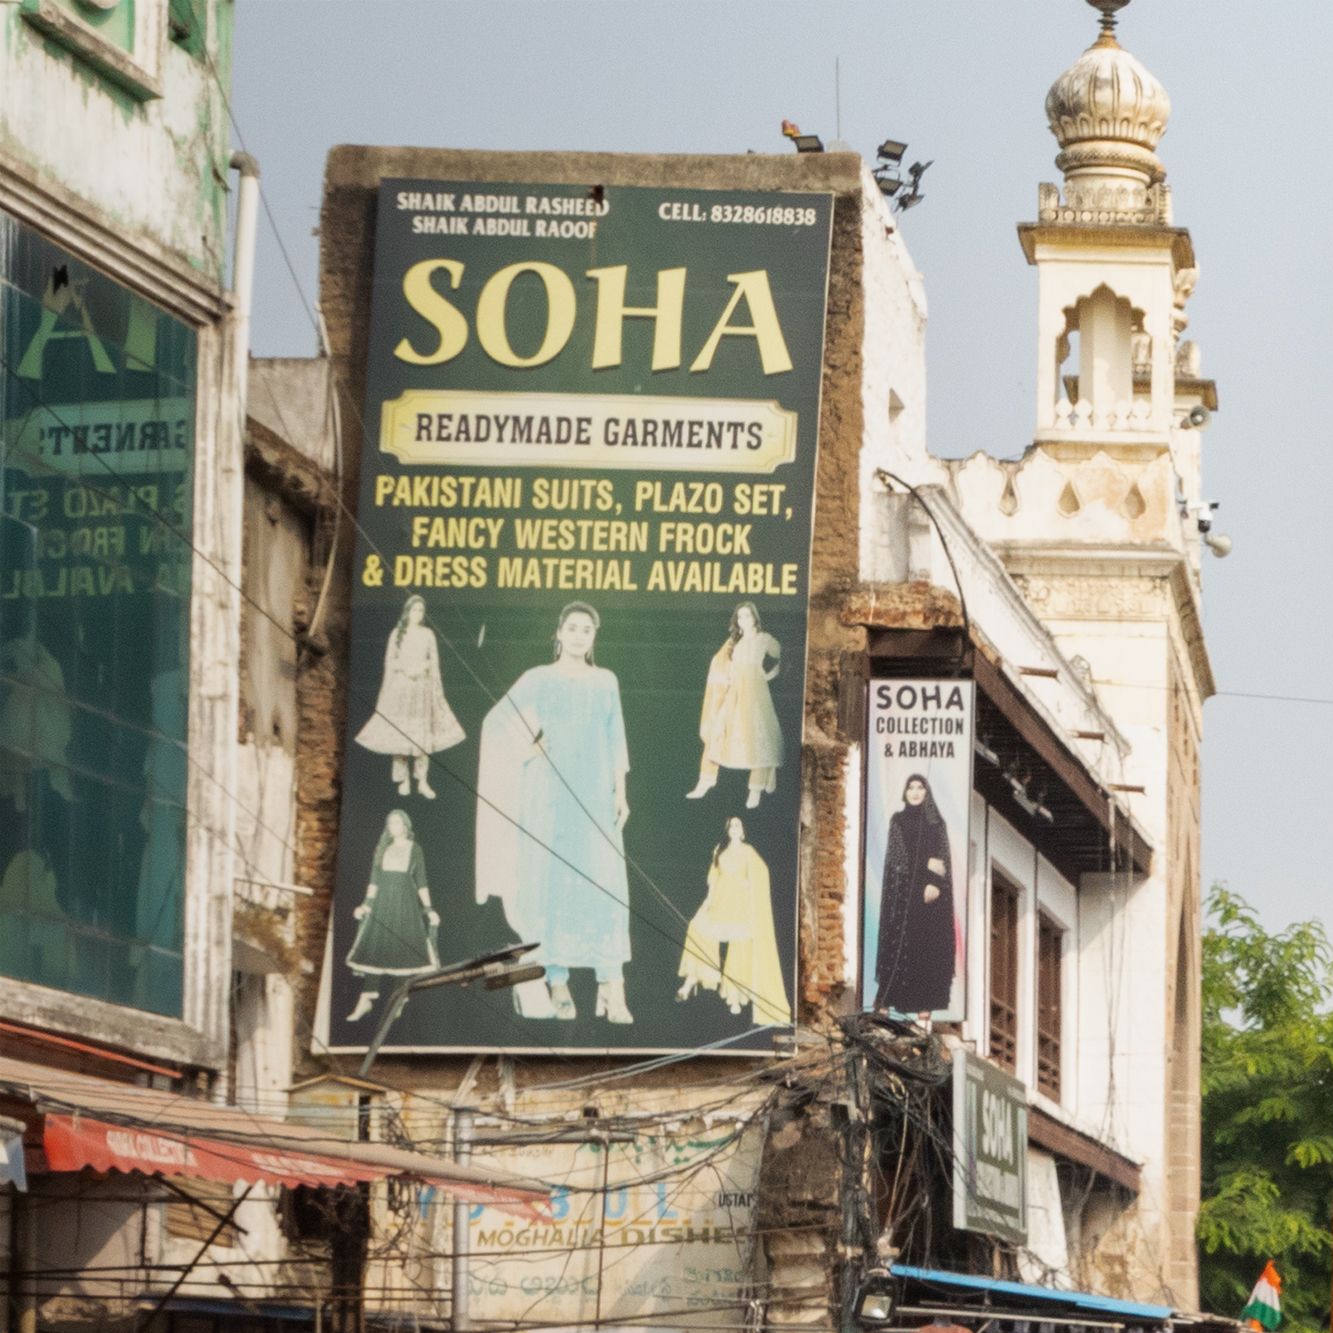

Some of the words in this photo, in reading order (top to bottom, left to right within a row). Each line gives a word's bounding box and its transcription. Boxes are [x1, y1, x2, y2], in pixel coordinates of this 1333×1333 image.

[397, 192, 456, 211] SHAIK
[460, 194, 521, 213] ABDUL
[526, 196, 610, 217] RASHEED
[711, 204, 817, 226] 8328618838
[412, 215, 469, 235] SHAIK
[473, 217, 531, 237] ABDUL
[535, 219, 598, 239] RAOOF
[394, 258, 794, 375] SOHA
[415, 412, 592, 446] READYMADE
[603, 416, 764, 451] GARMENTS
[375, 474, 522, 508] PAKISTANI
[533, 478, 624, 514] SUITS,
[634, 480, 725, 514] PLAZO
[733, 483, 794, 520] SET,
[411, 516, 509, 550] FANCY
[514, 518, 649, 553] WESTERN
[659, 522, 752, 556] FROCK
[362, 555, 384, 587] &
[394, 554, 488, 587] DRESS
[497, 557, 638, 591] MATERIAL
[647, 561, 799, 596] AVAILABLE
[875, 685, 965, 712] SOHA
[875, 716, 965, 737] COLLECTION
[884, 742, 895, 758] &
[898, 739, 956, 760] ABHAYA
